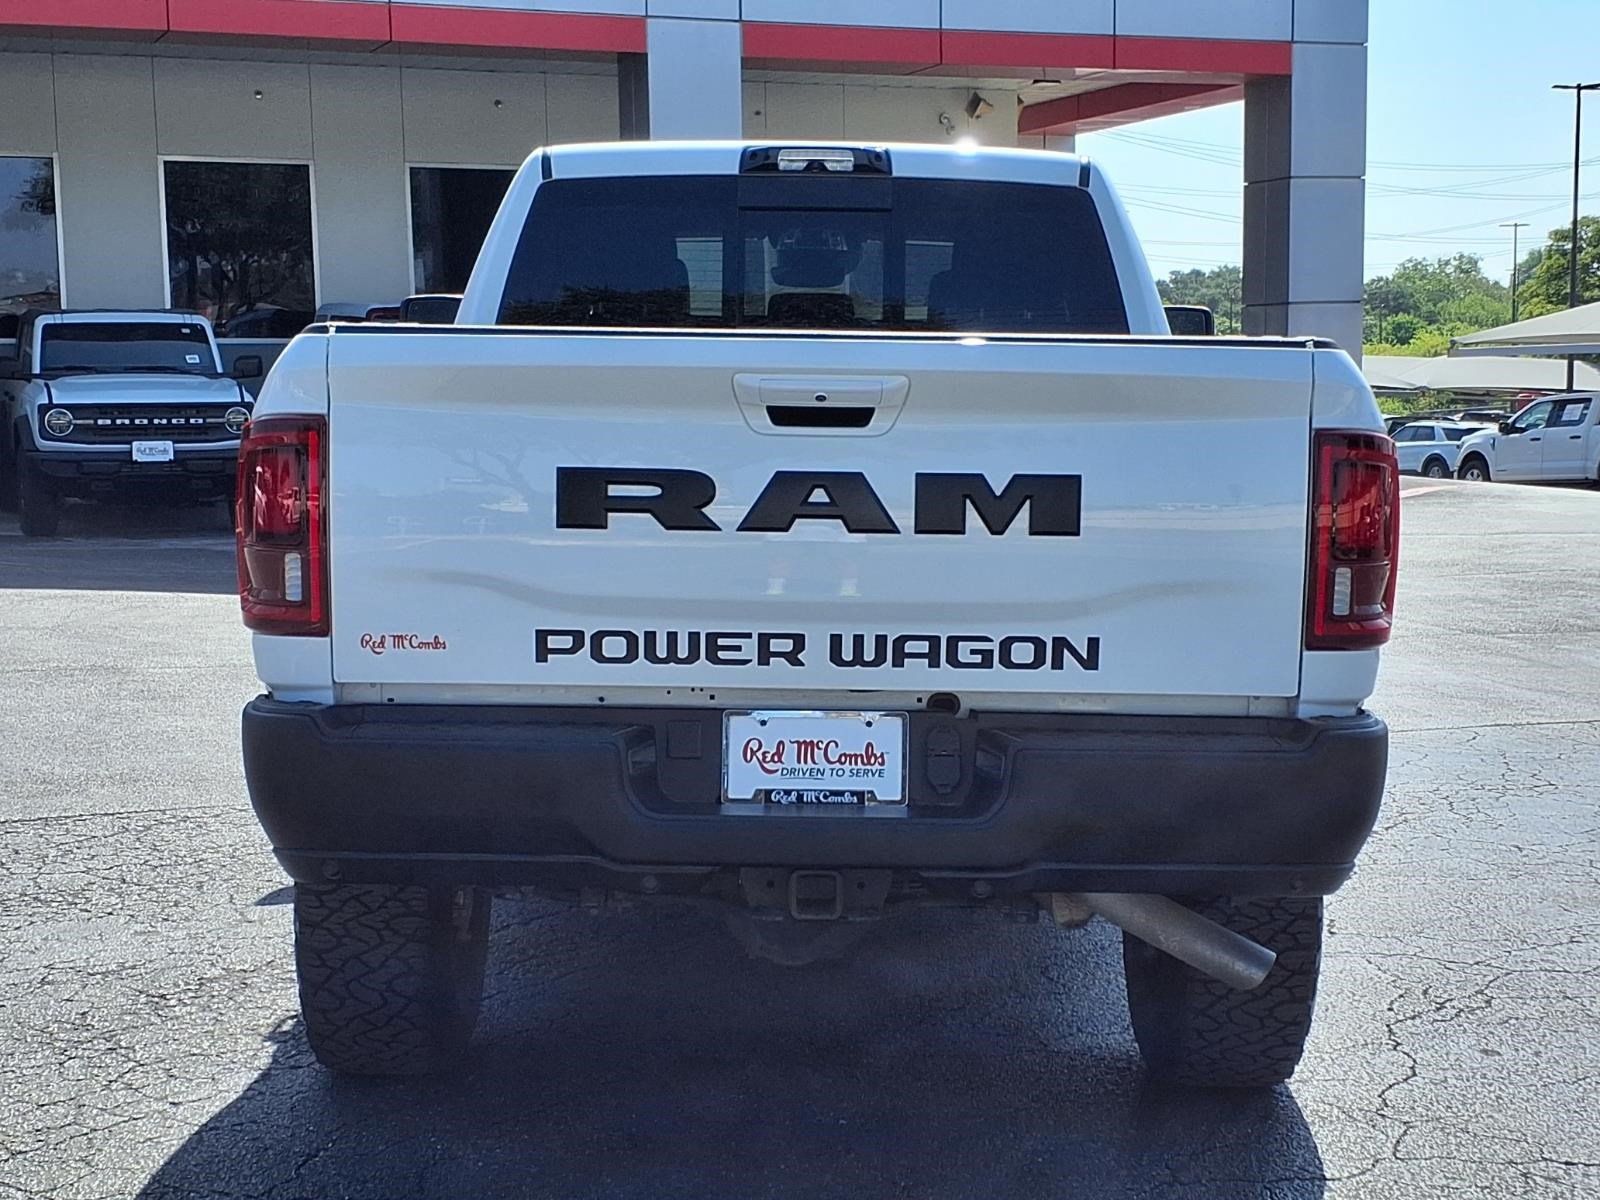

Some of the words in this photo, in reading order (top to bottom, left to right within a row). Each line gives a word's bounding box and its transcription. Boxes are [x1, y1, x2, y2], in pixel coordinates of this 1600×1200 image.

[555, 466, 1082, 537] RAM
[360, 633, 386, 655] Red
[388, 634, 447, 650] McCombs
[534, 628, 806, 668] POWER
[828, 633, 1101, 671] WAGON
[742, 737, 786, 775] Red
[789, 739, 886, 767] McCombs
[780, 767, 825, 778] DRIVEN
[830, 768, 846, 778] TO
[848, 768, 885, 778] SERVE
[770, 789, 797, 805] Red
[800, 790, 858, 803] McCombs
